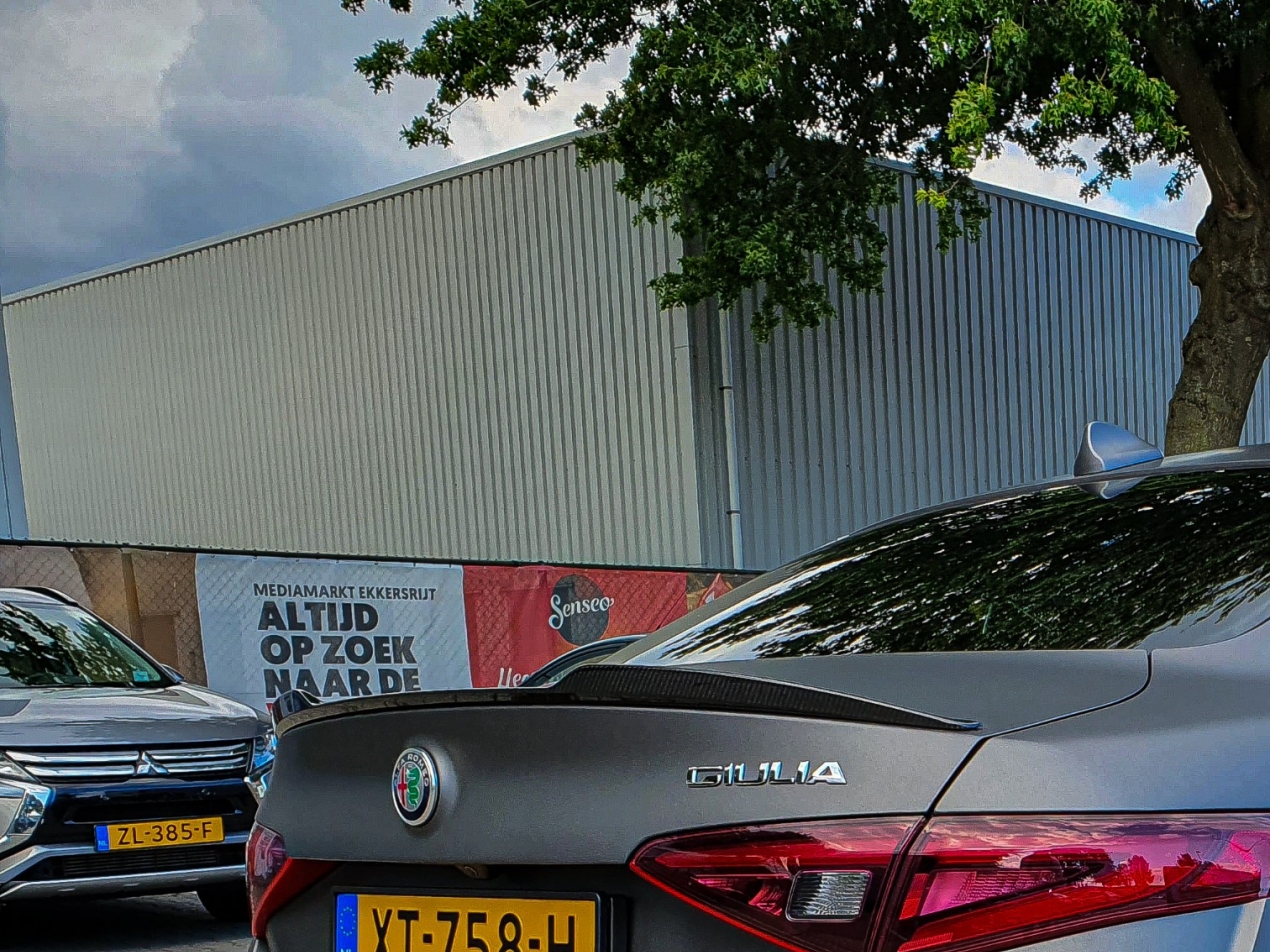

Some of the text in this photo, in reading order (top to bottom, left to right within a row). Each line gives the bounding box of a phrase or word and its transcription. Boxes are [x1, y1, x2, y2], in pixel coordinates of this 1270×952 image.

[253, 583, 437, 601] MEDIAMARKT EKKERSRIJT
[257, 601, 379, 632] ALTIJD
[549, 594, 614, 630] Senseo
[260, 634, 418, 665] OP ZOEK
[263, 667, 422, 699] NAAR DE
[407, 753, 430, 787] ROMEO
[685, 760, 848, 788] GIULIA
[117, 821, 213, 846] ZL-385-F
